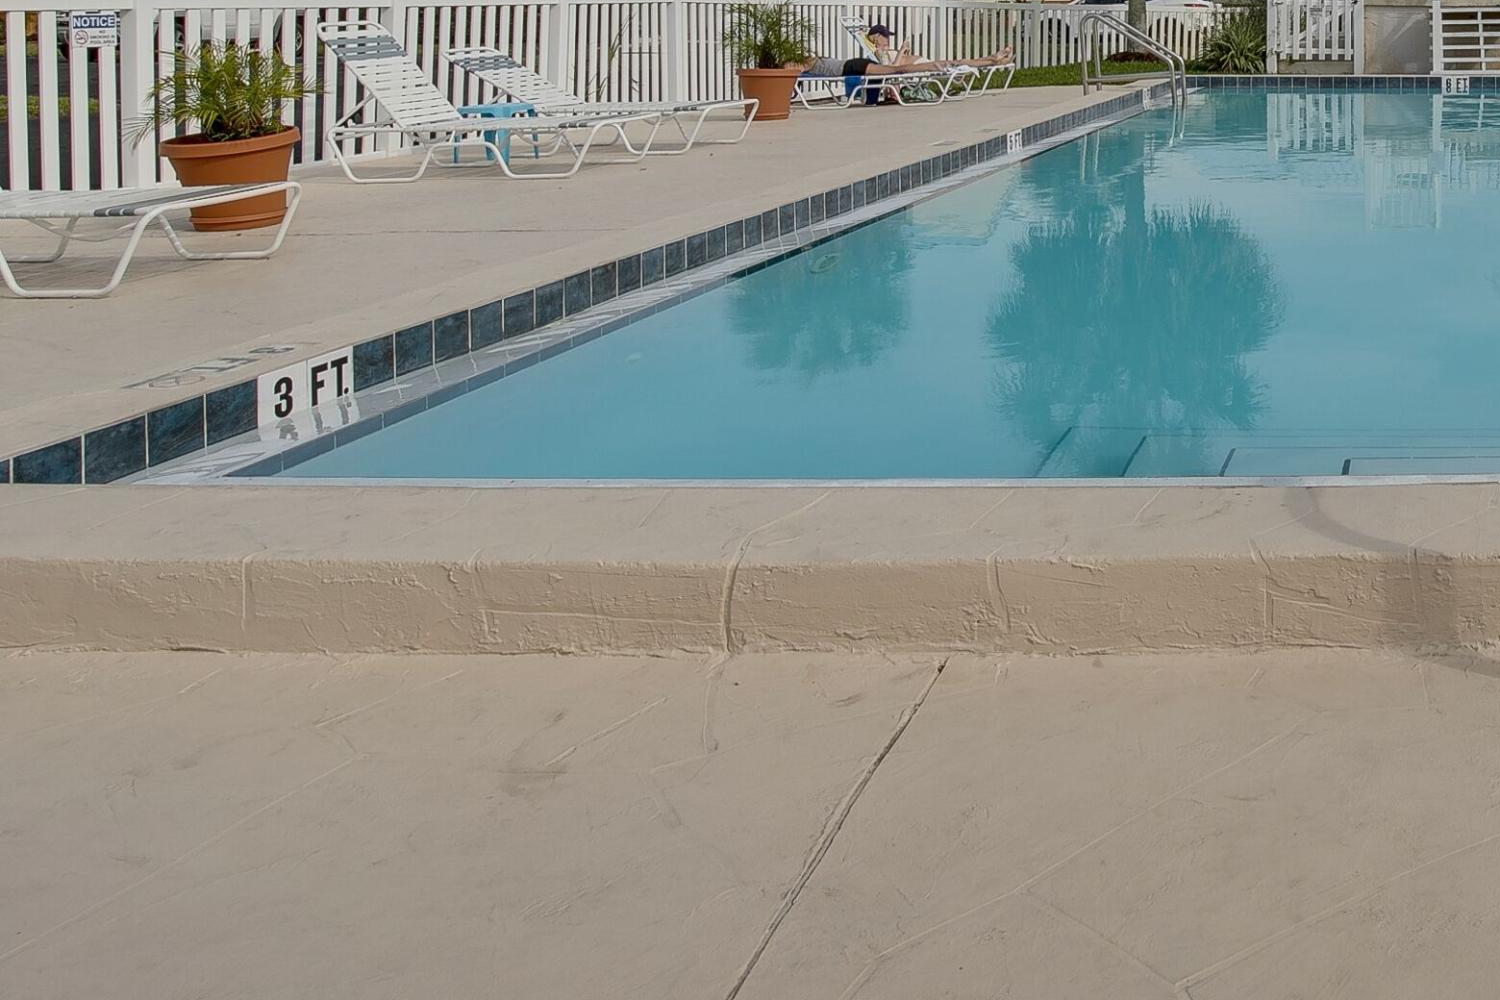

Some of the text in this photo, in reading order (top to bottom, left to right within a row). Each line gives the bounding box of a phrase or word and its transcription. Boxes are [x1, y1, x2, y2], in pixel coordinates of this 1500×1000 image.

[73, 16, 115, 27] NOTICE
[1009, 135, 1014, 150] 5
[274, 356, 349, 418] 3 FT.
